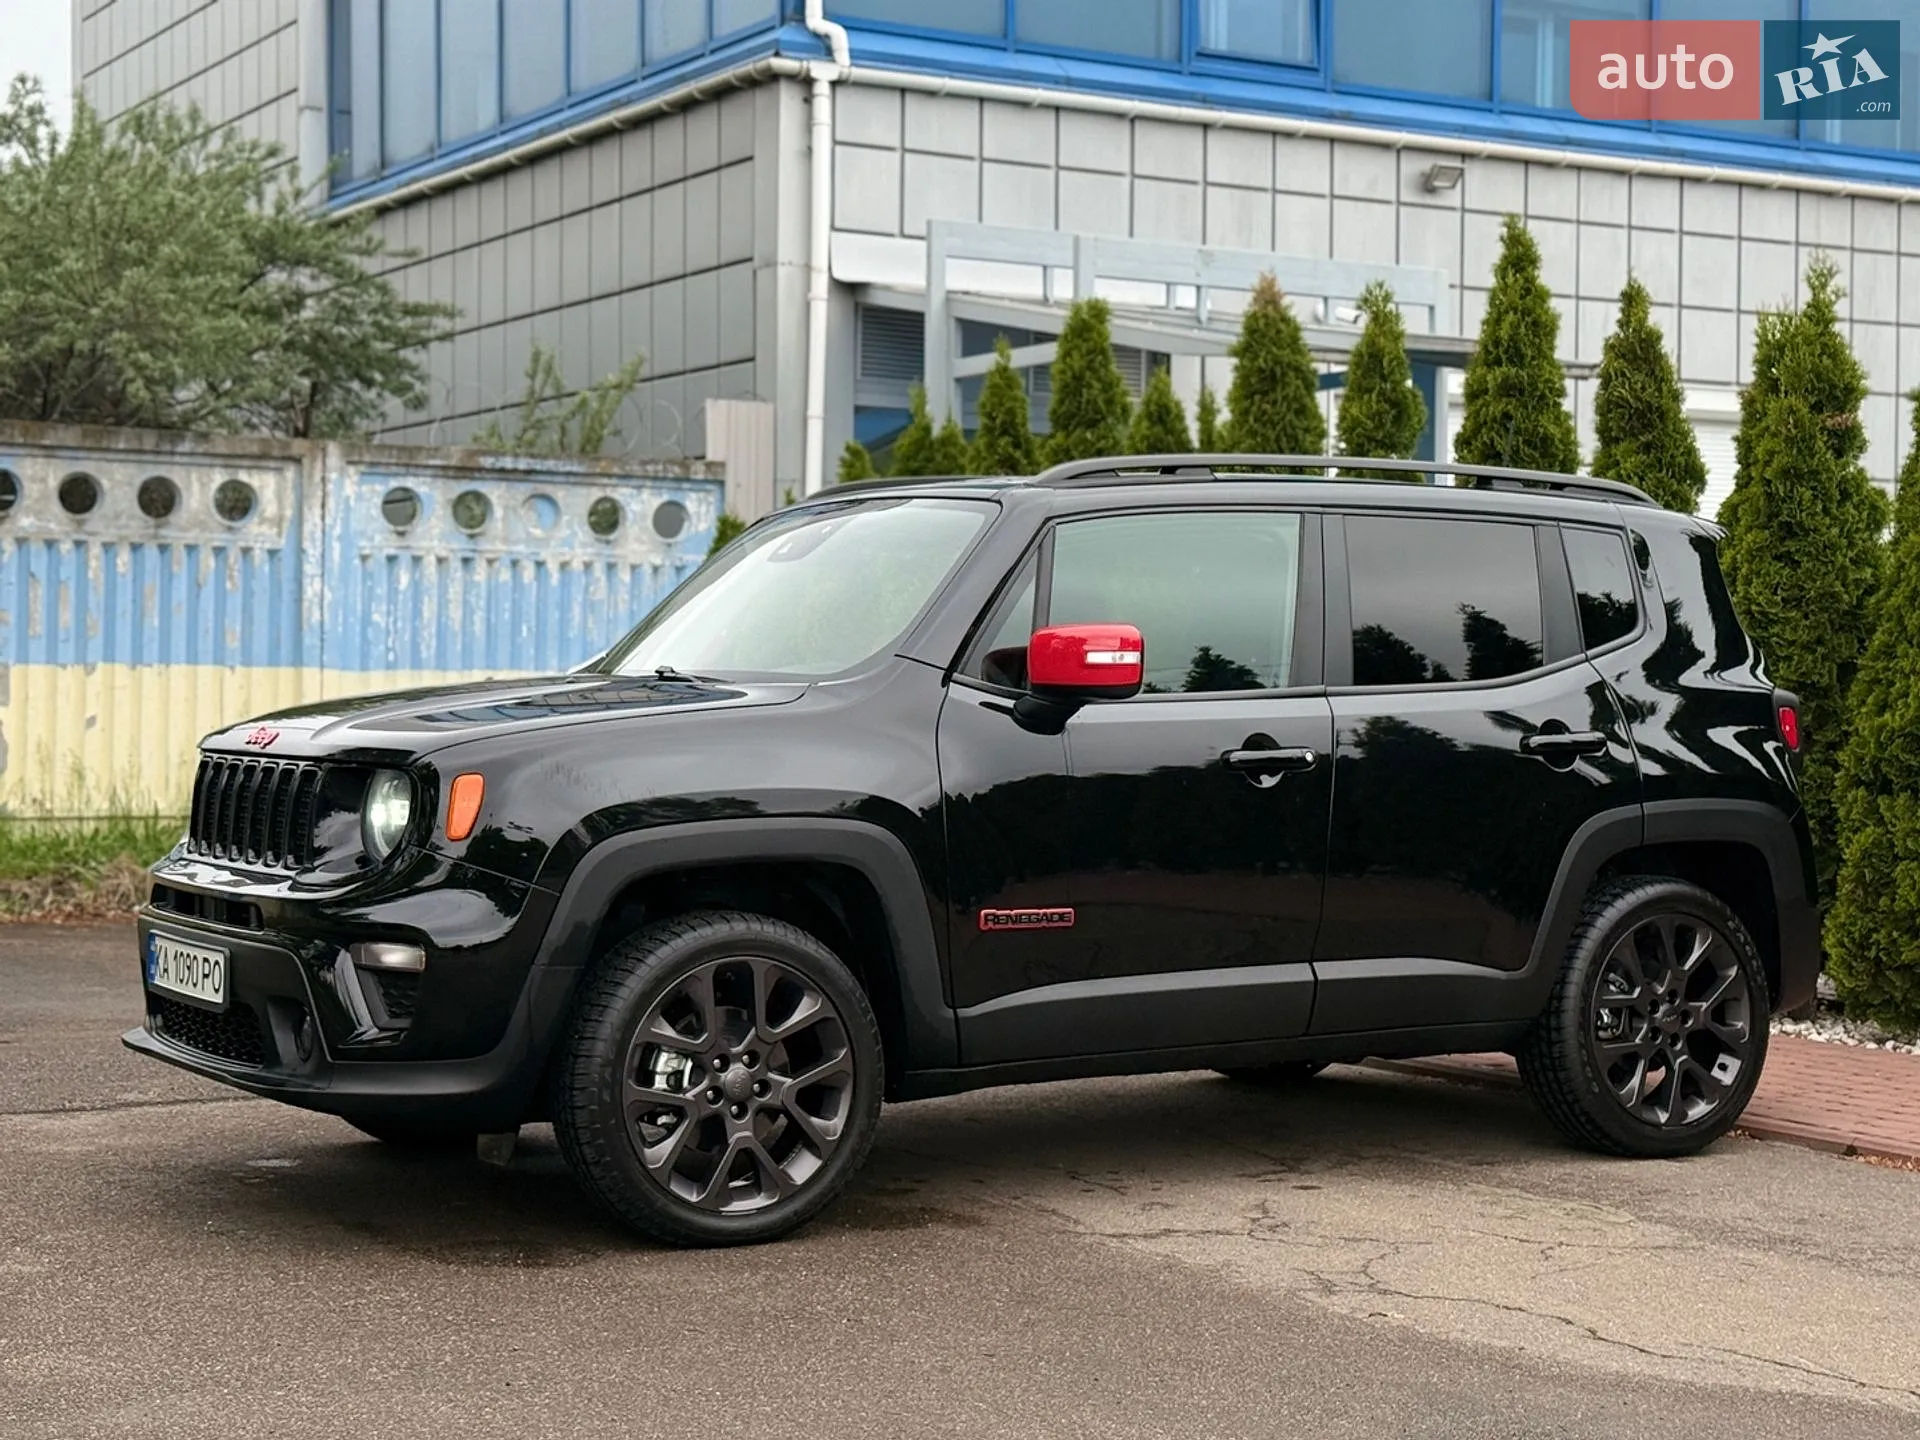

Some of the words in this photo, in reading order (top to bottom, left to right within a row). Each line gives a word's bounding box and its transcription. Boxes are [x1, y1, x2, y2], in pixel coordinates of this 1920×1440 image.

[982, 909, 1073, 928] RENEGADE
[155, 943, 170, 980] KA
[173, 949, 199, 988] 1090
[201, 956, 222, 994] PO
